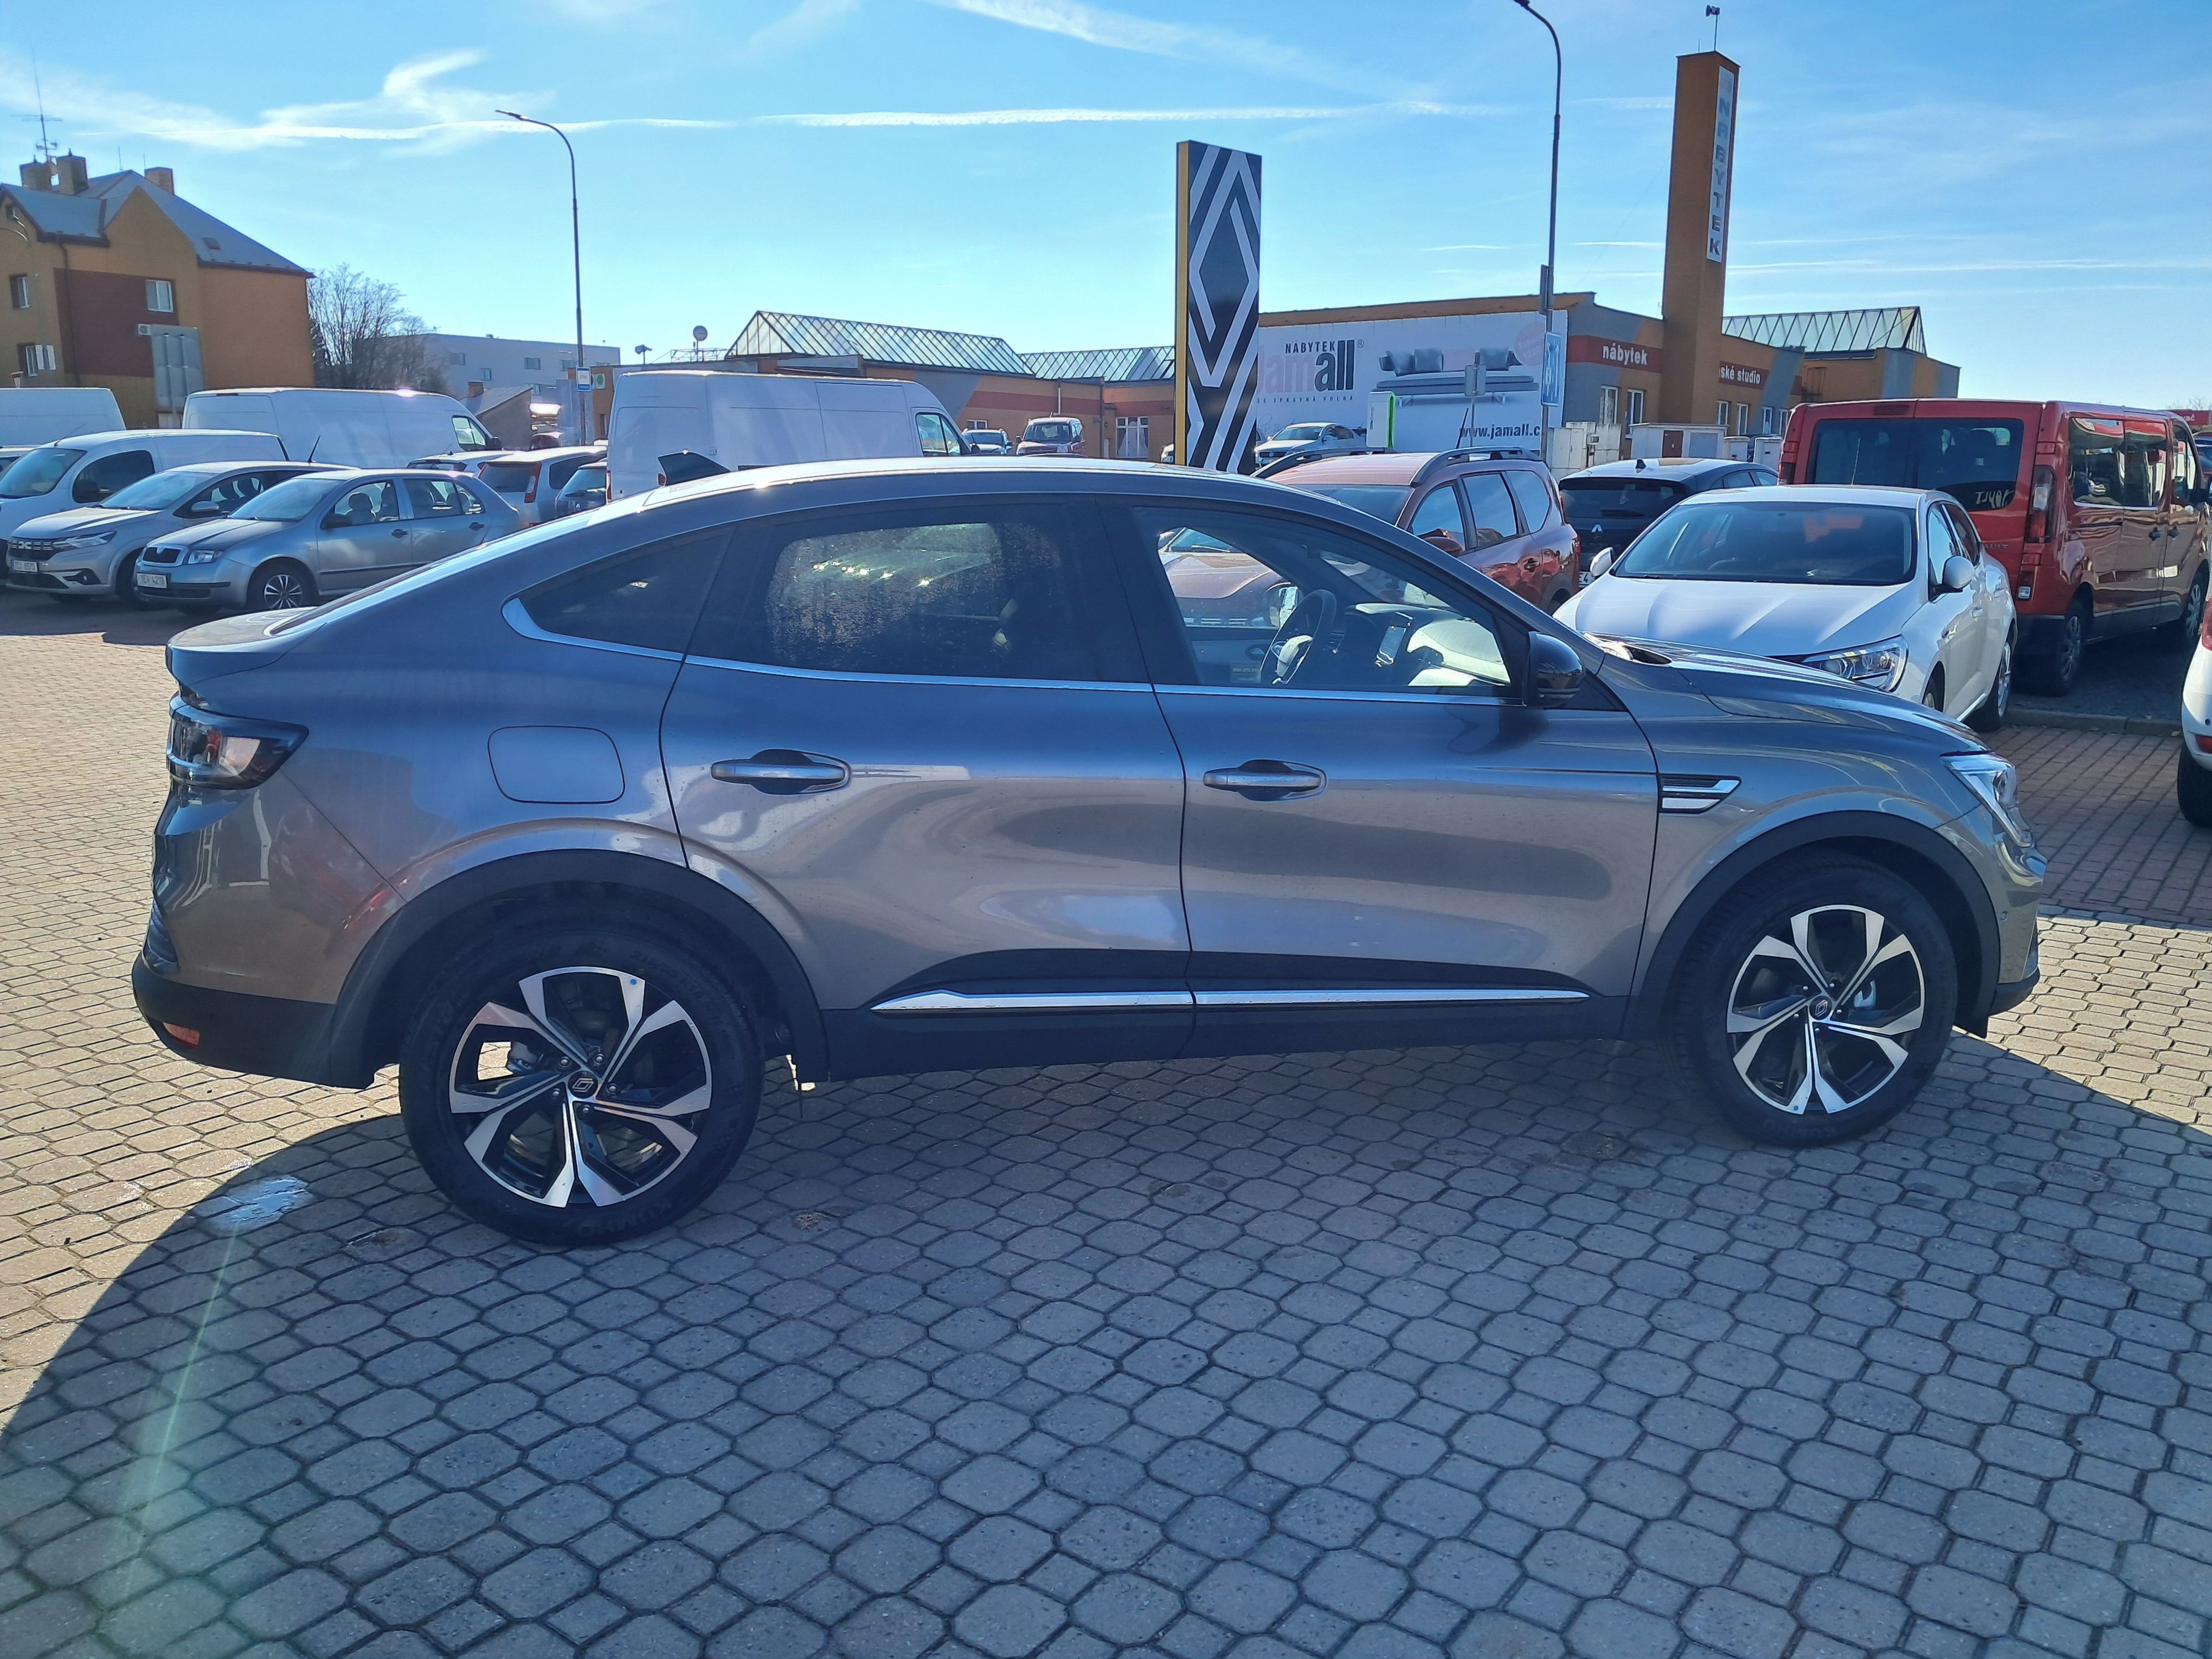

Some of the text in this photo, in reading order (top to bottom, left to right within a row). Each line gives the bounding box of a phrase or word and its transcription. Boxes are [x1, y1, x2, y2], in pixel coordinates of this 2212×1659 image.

[1285, 340, 1335, 353] NÁBYTEK
[1603, 343, 1648, 365] nábytek
[1737, 369, 1760, 384] studio
